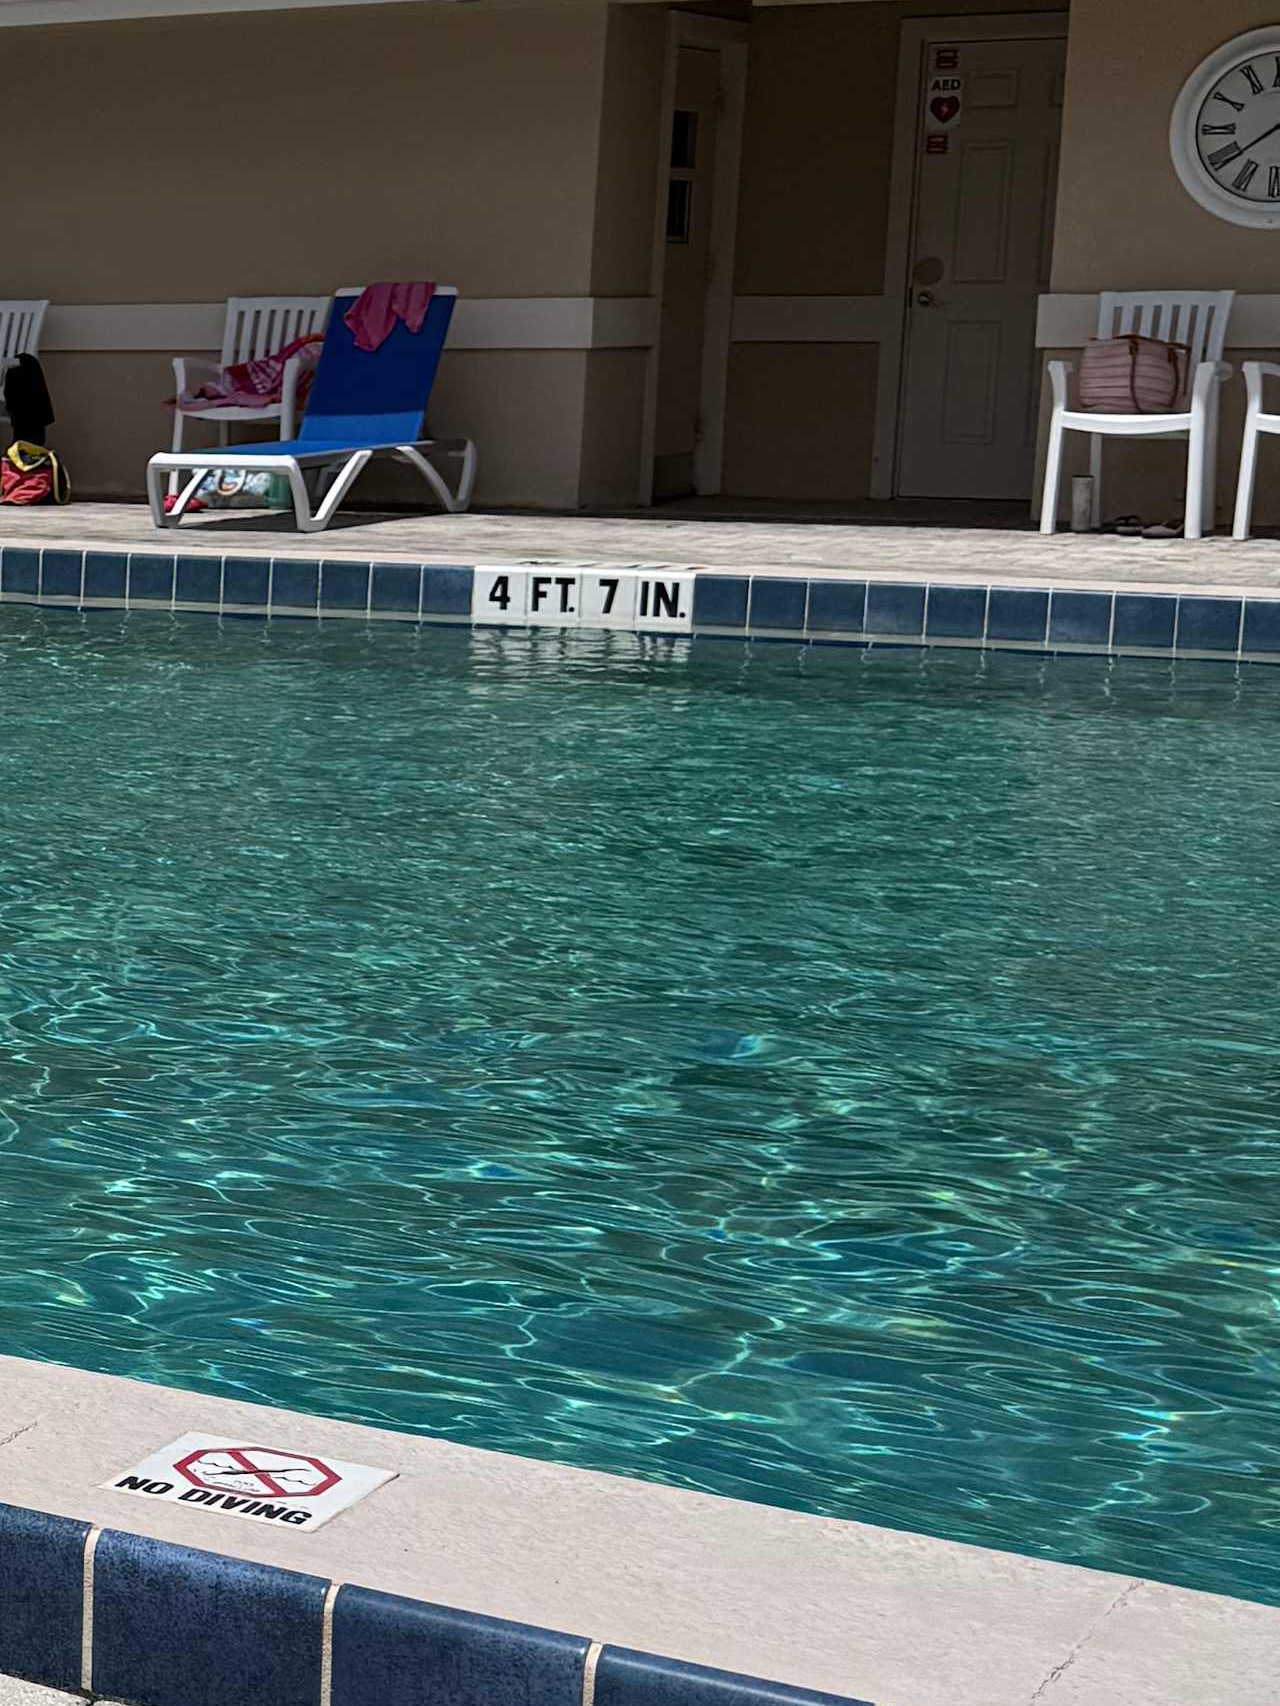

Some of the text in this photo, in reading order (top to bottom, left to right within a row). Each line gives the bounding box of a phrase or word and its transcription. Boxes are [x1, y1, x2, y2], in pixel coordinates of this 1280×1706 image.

[932, 79, 960, 91] AED
[488, 575, 686, 618] 4 FT. 7 IN.
[114, 1475, 313, 1526] NO DIVING
